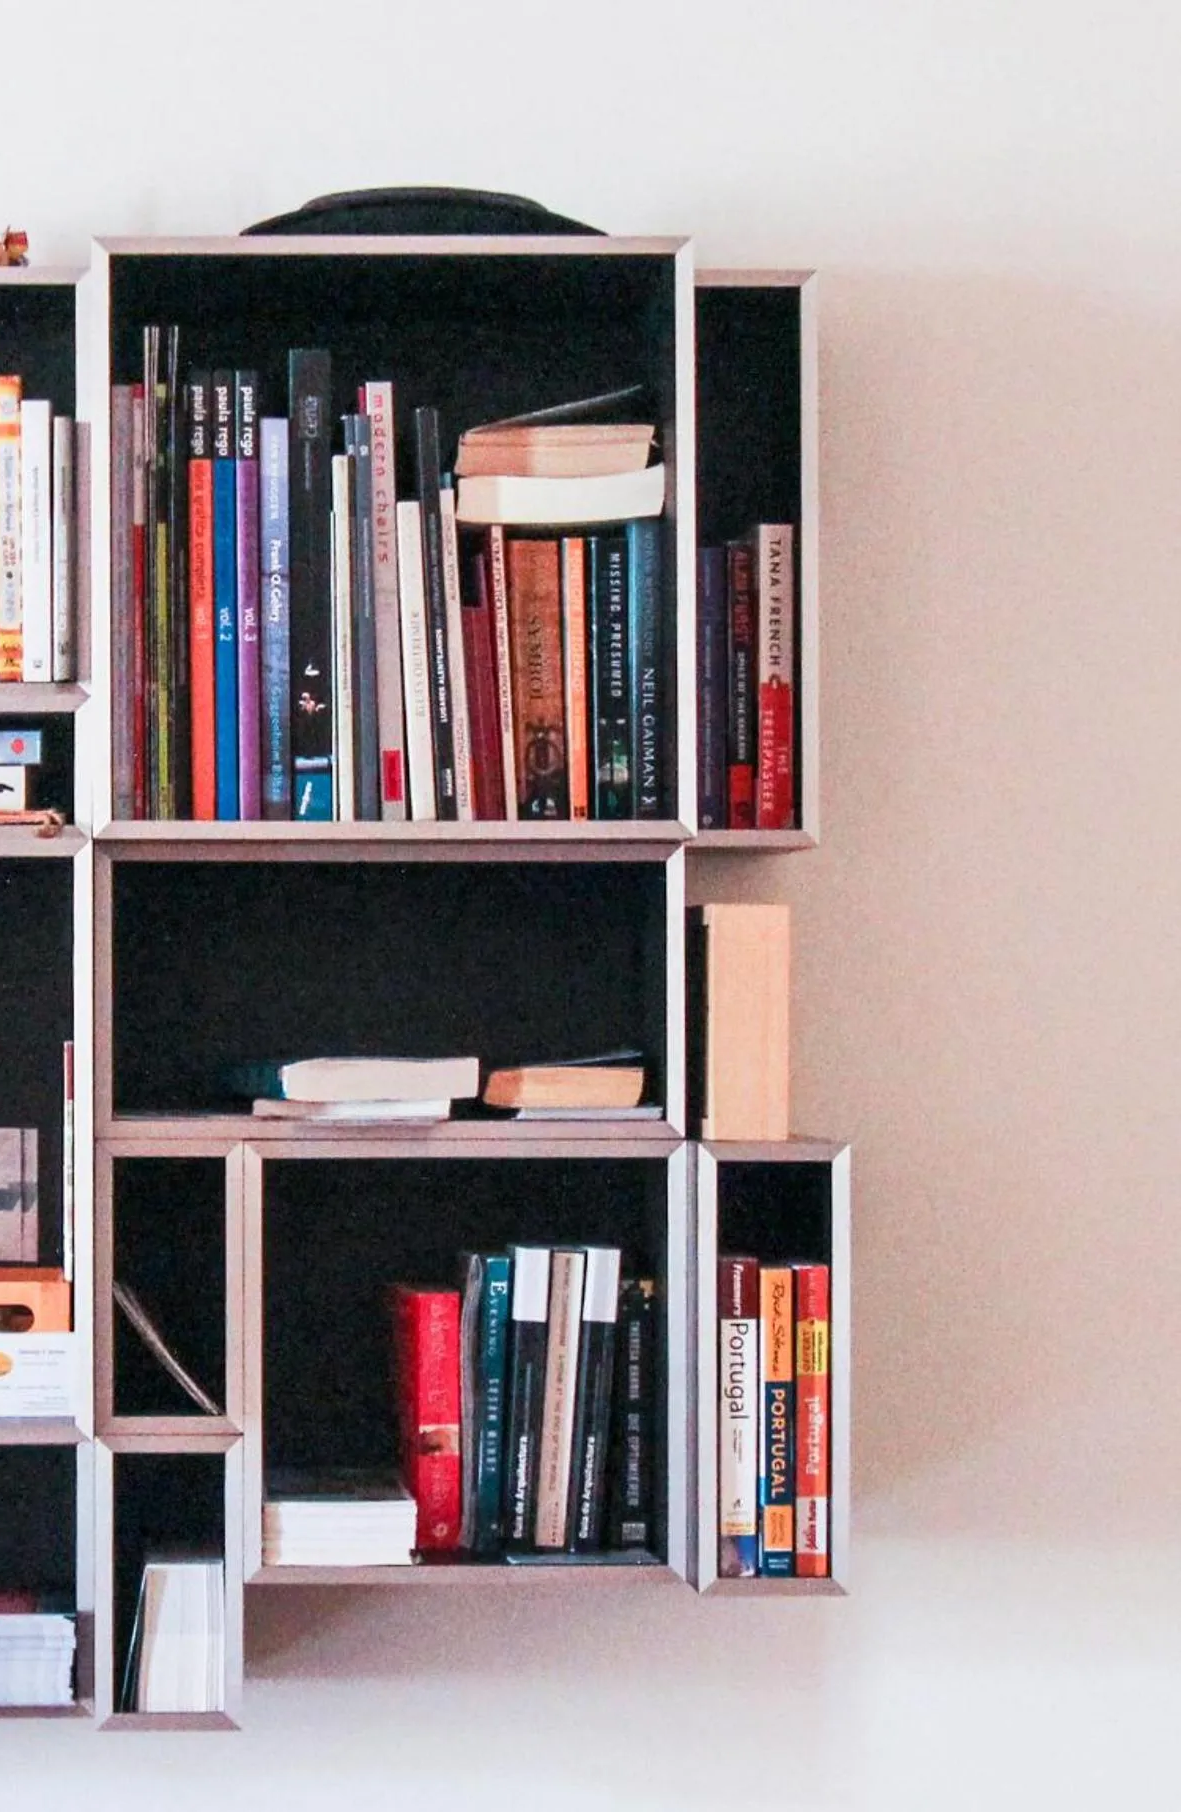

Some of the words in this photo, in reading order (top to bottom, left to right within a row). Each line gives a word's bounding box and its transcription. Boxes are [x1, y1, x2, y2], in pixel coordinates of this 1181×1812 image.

[191, 386, 205, 422] paula
[215, 386, 230, 422] paula
[240, 386, 255, 423] paula
[191, 426, 205, 456] rego
[215, 426, 230, 456] rego
[240, 426, 255, 456] rego
[372, 393, 387, 478] modern
[376, 488, 391, 564] chairs
[768, 538, 782, 588] TANA
[219, 606, 232, 628] vol.
[244, 607, 256, 628] vol.
[768, 595, 782, 667] FRENCH
[527, 615, 544, 702] SYMBOL
[609, 623, 623, 698] PRESUMED
[642, 667, 656, 709] NEIL
[641, 715, 656, 788] GAIMAN
[761, 708, 775, 811] TRESPASSER
[776, 745, 788, 775] THE
[487, 1279, 507, 1357] EVENING
[724, 1320, 749, 1419] Portugal
[770, 1387, 786, 1498] PORTUGAL
[803, 1395, 824, 1476] Portugal
